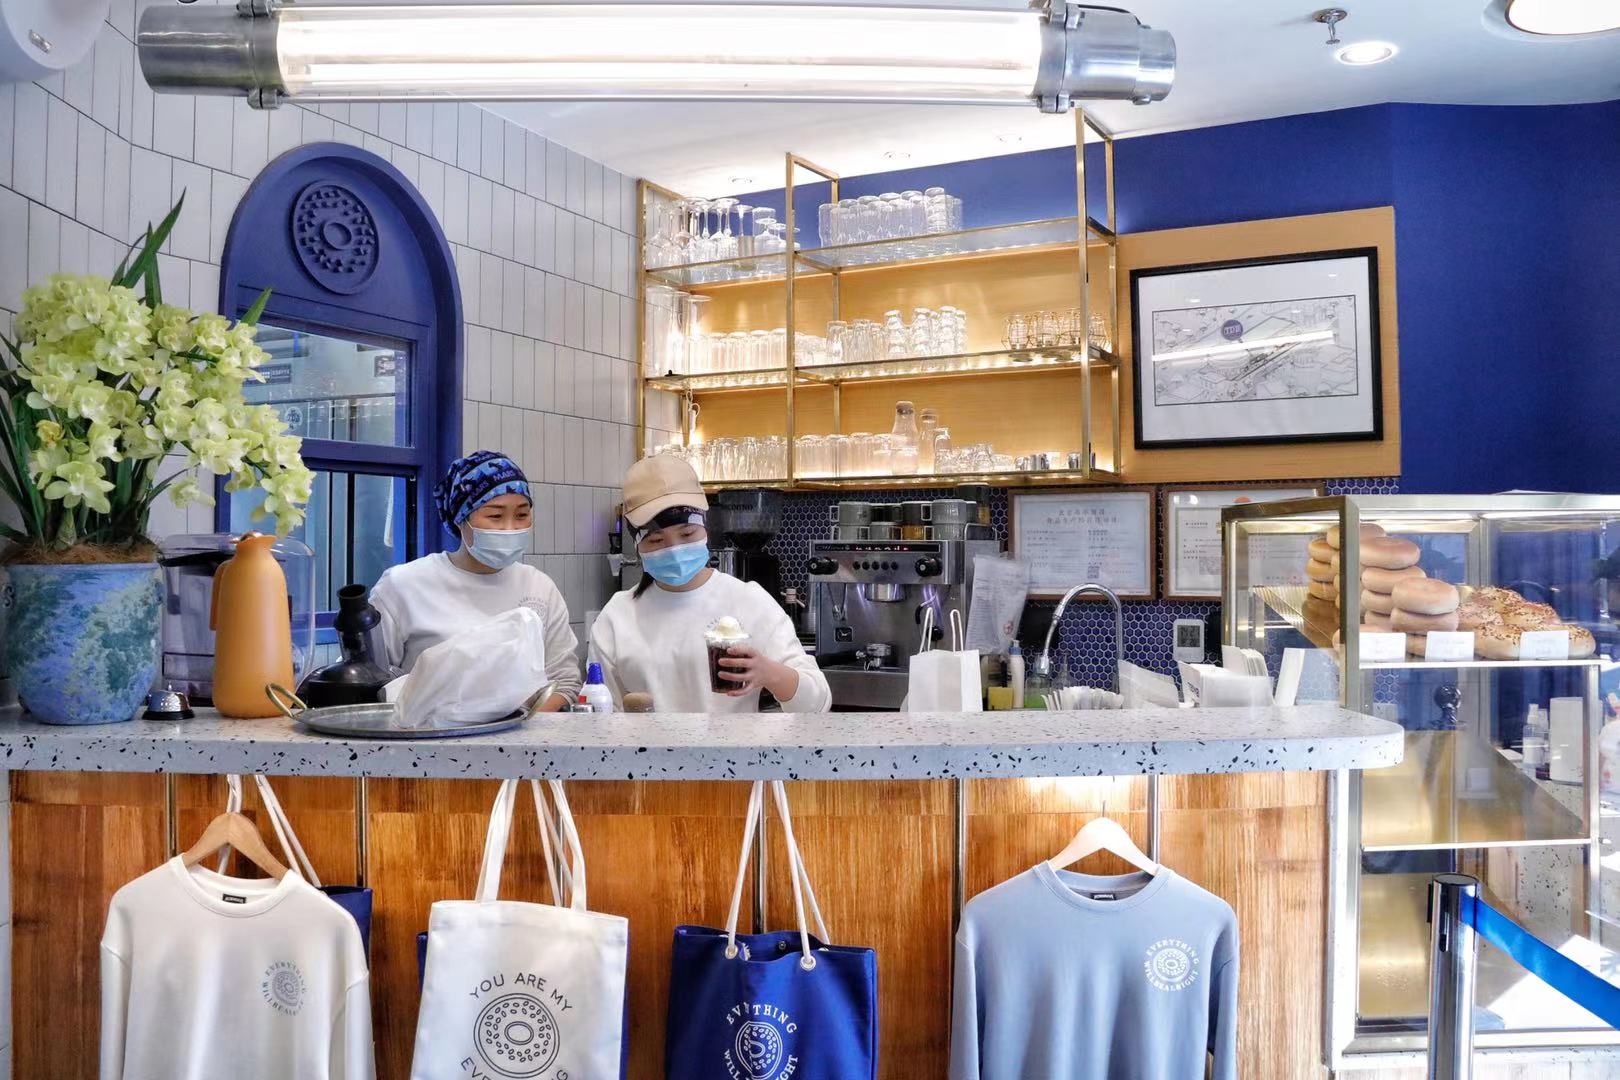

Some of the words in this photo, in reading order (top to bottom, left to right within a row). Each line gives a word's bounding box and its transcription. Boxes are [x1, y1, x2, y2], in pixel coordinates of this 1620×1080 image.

[470, 974, 505, 999] YOU
[514, 972, 547, 992] ARE
[550, 988, 573, 1012] MY
